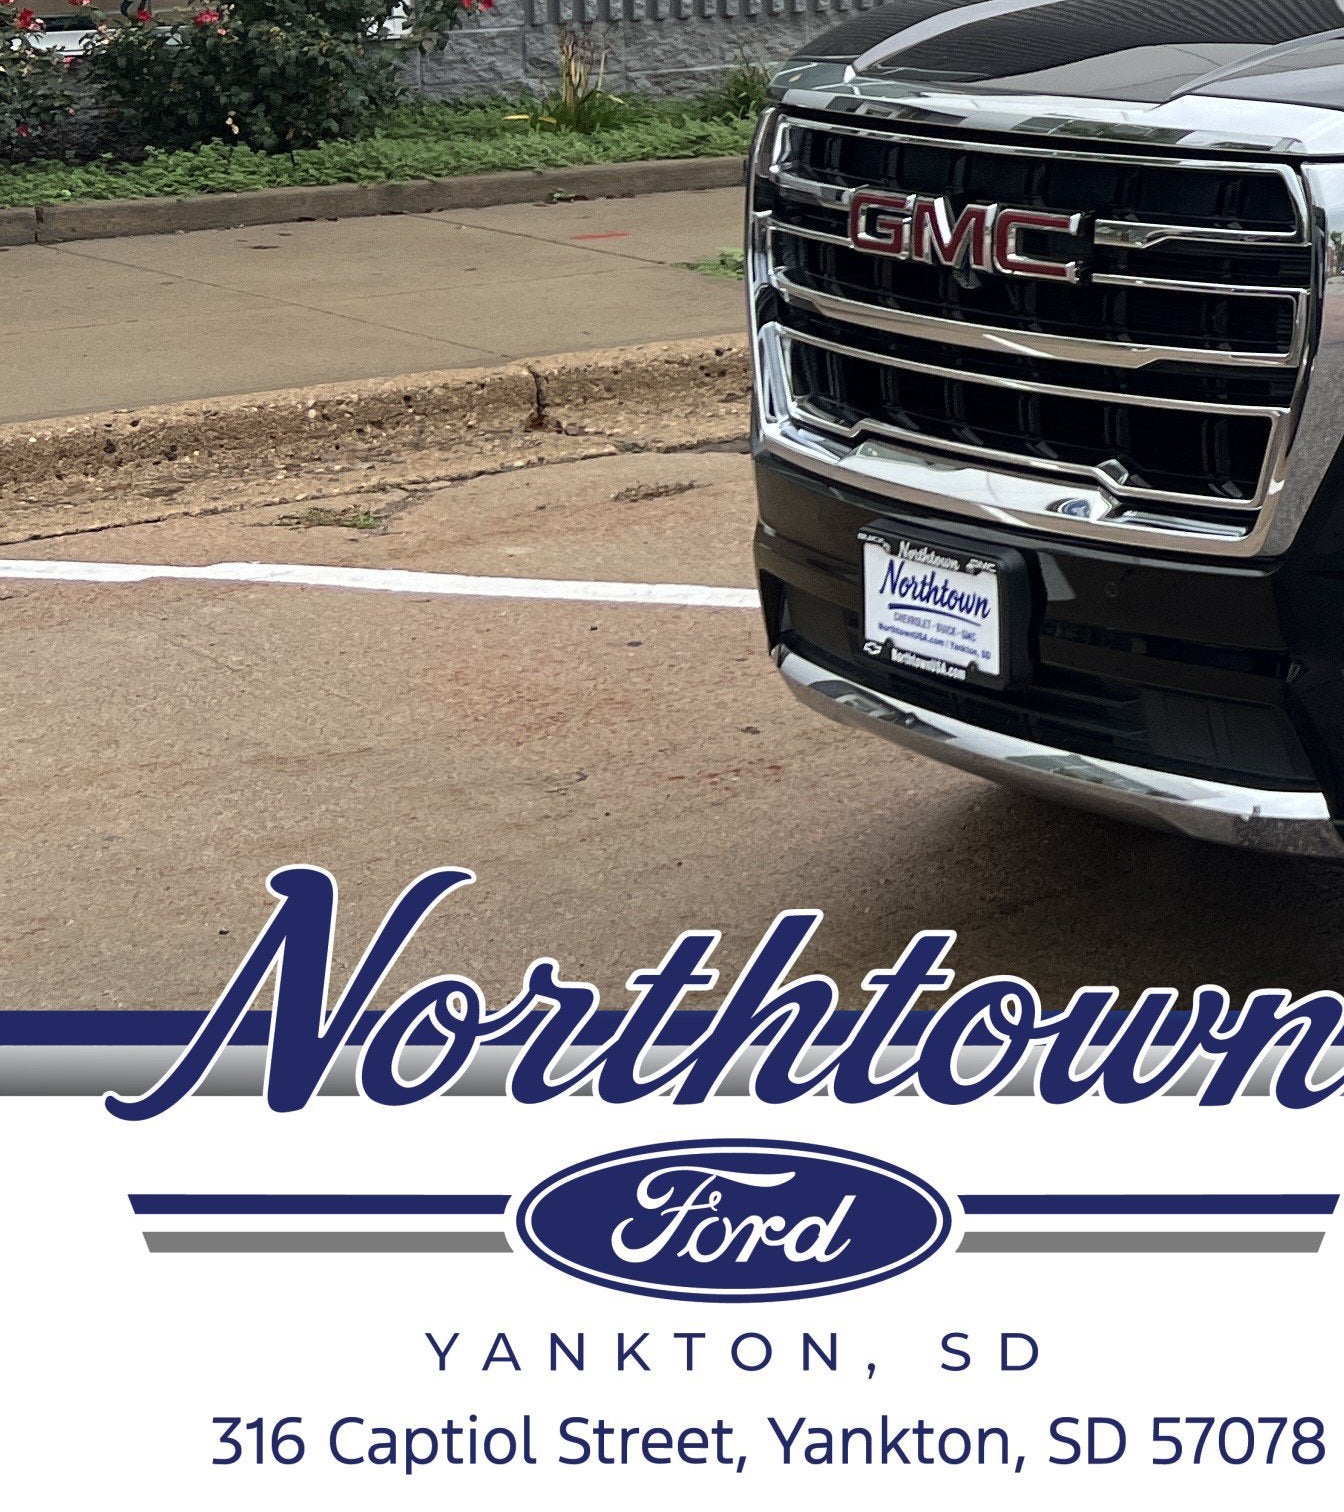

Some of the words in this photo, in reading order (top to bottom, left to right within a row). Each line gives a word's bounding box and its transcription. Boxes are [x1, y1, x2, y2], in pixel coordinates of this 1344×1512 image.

[848, 187, 1082, 284] GMC
[898, 541, 960, 571] Northtown
[878, 558, 992, 620] Northtown
